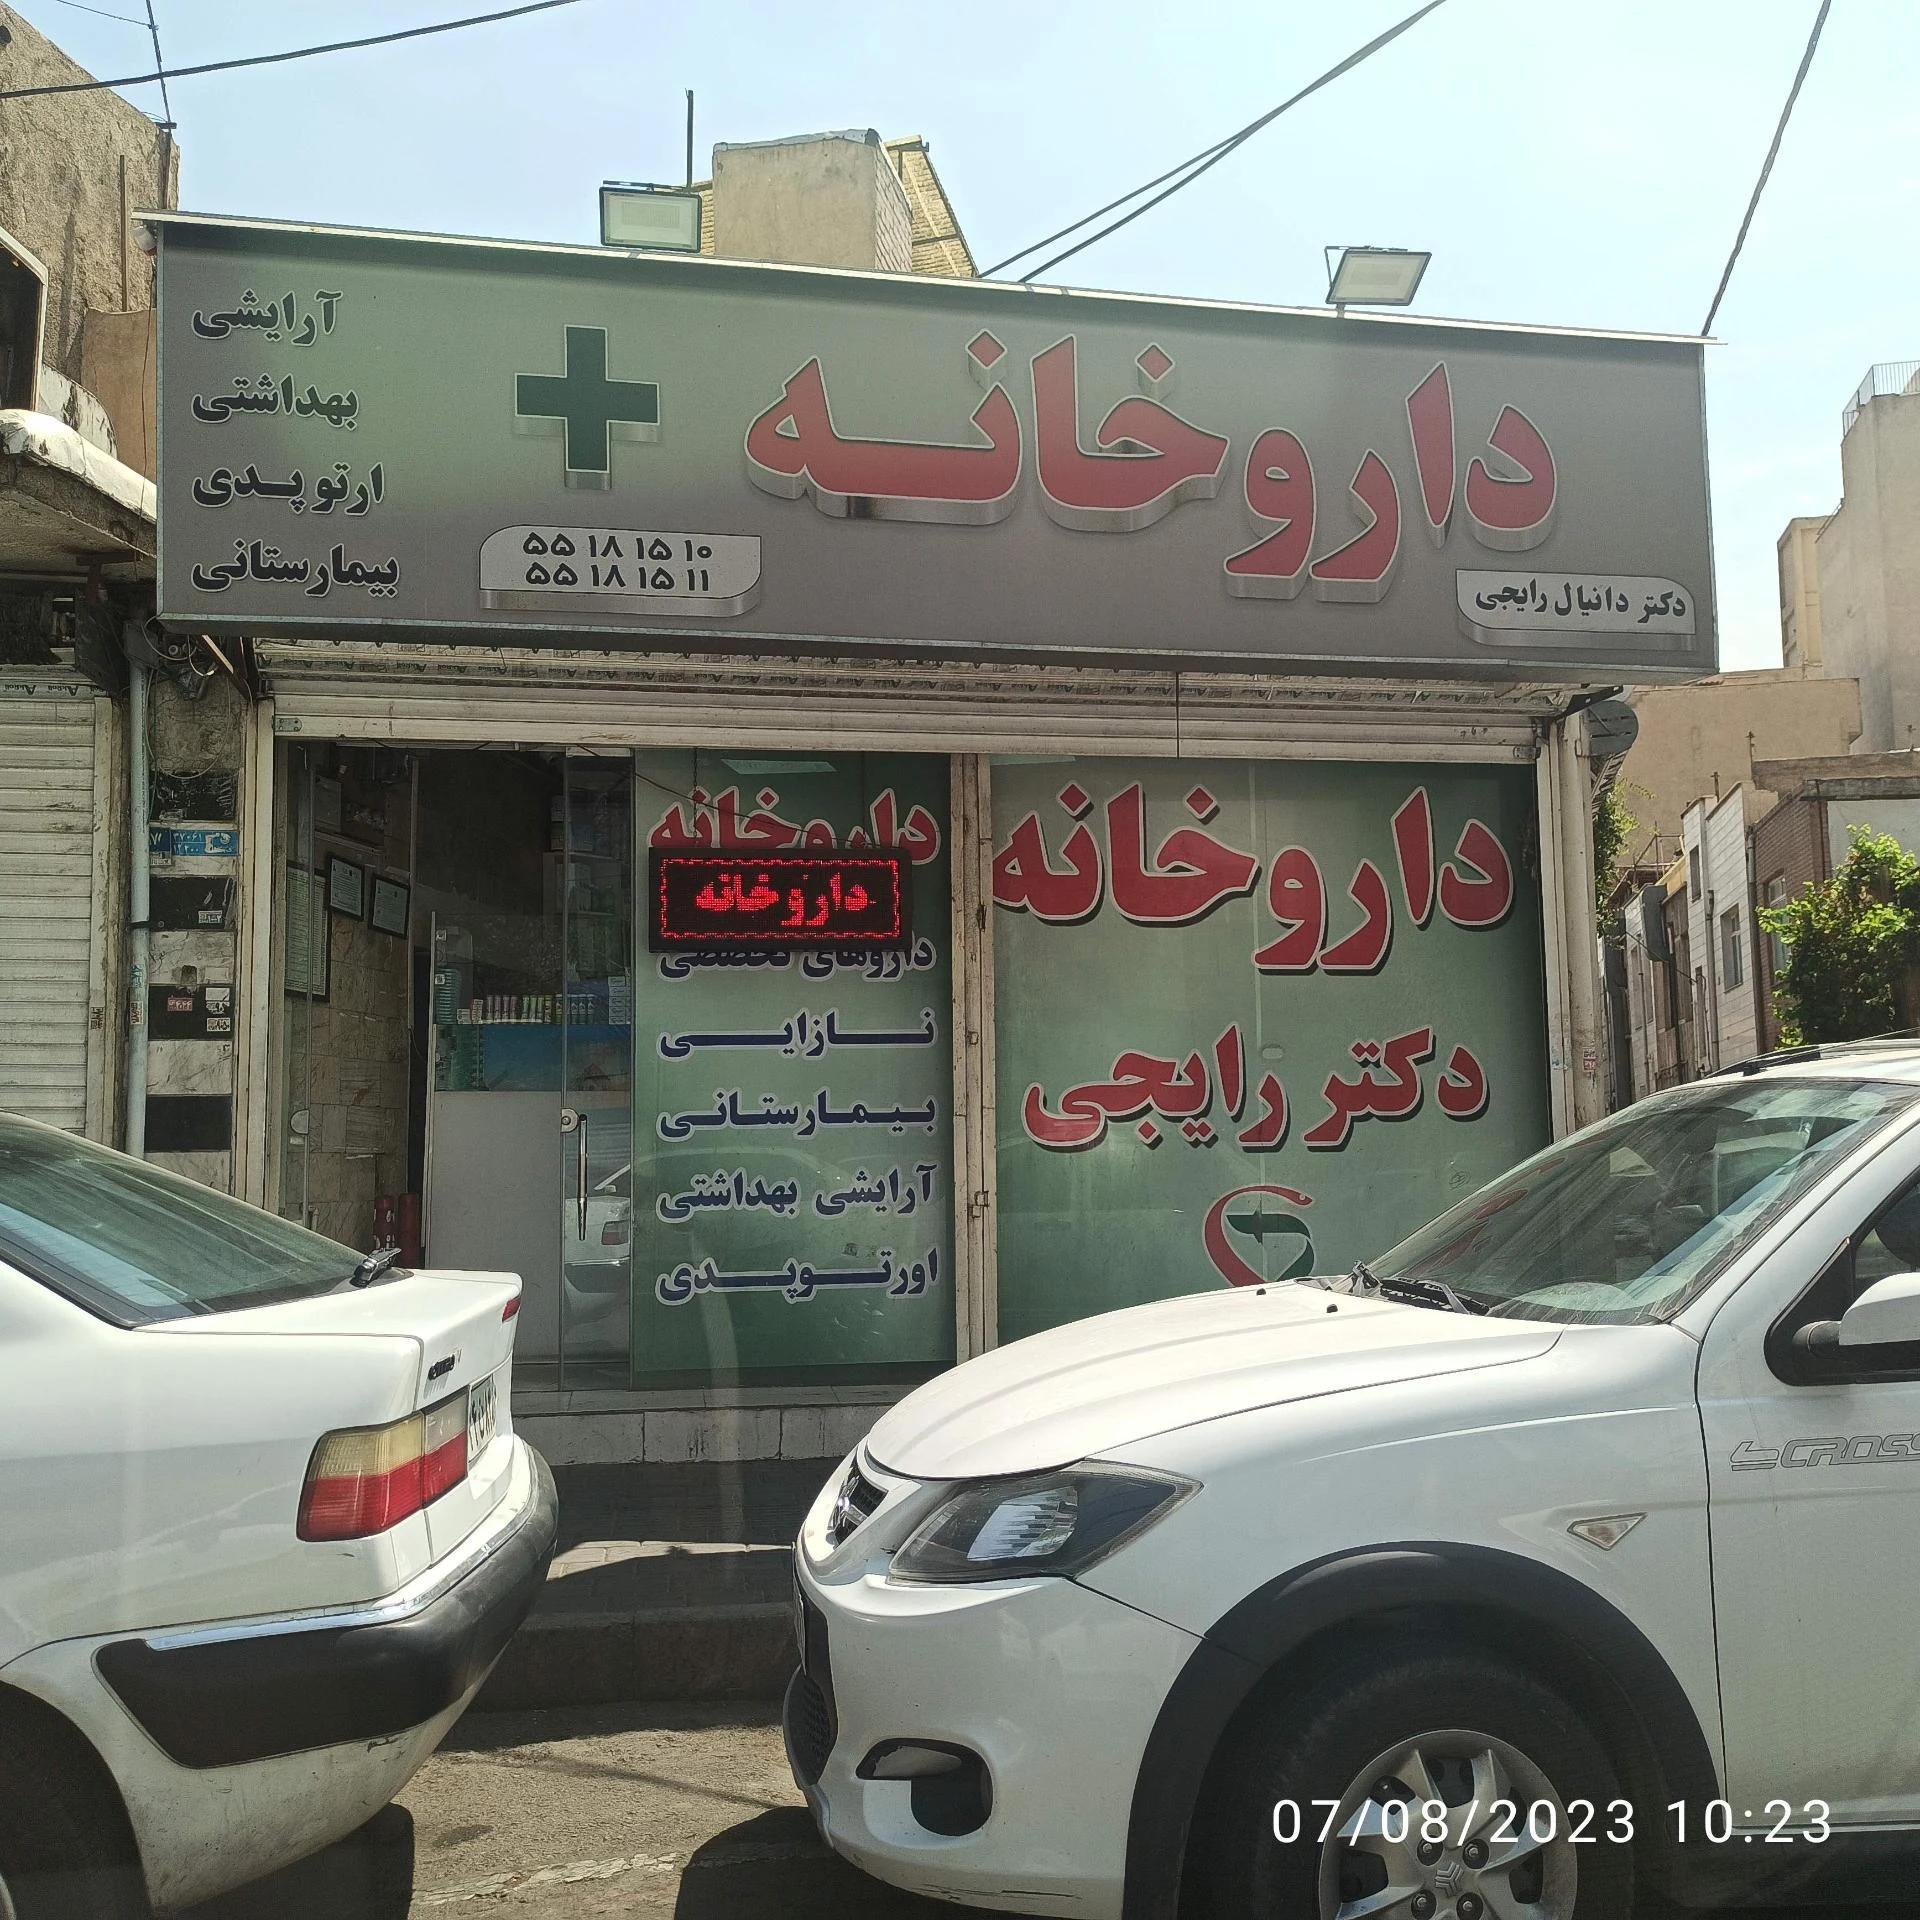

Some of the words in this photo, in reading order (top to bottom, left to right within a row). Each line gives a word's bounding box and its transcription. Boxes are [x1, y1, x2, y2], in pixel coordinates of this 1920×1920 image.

[191, 288, 343, 347] آرایشی
[191, 373, 359, 430] بهداشتی
[745, 329, 1559, 590] داروخانه
[191, 537, 401, 598] بیمارستانی
[522, 531, 576, 557] ۵۵
[588, 534, 625, 559] ۱۸
[636, 536, 673, 561] ۱۵
[525, 561, 579, 587] ۵۵
[590, 564, 627, 588] ۱۸
[638, 566, 675, 591] ۱۵
[1474, 577, 1549, 613] رایجی
[1554, 581, 1630, 617] دانیال
[1637, 590, 1687, 624] دکتر
[694, 871, 869, 927] داروخانه
[991, 780, 1516, 976] داروخانه
[658, 1006, 938, 1061] نازایی
[656, 1085, 939, 1142] بیمارستانی
[1021, 1021, 1292, 1153] رایجی
[1303, 1025, 1492, 1152] دکتر
[656, 1166, 801, 1223] بهداشتی
[811, 1160, 939, 1218] آرایشی
[655, 1244, 941, 1305] اورتوپدی
[1780, 1433, 1920, 1469] CROS
